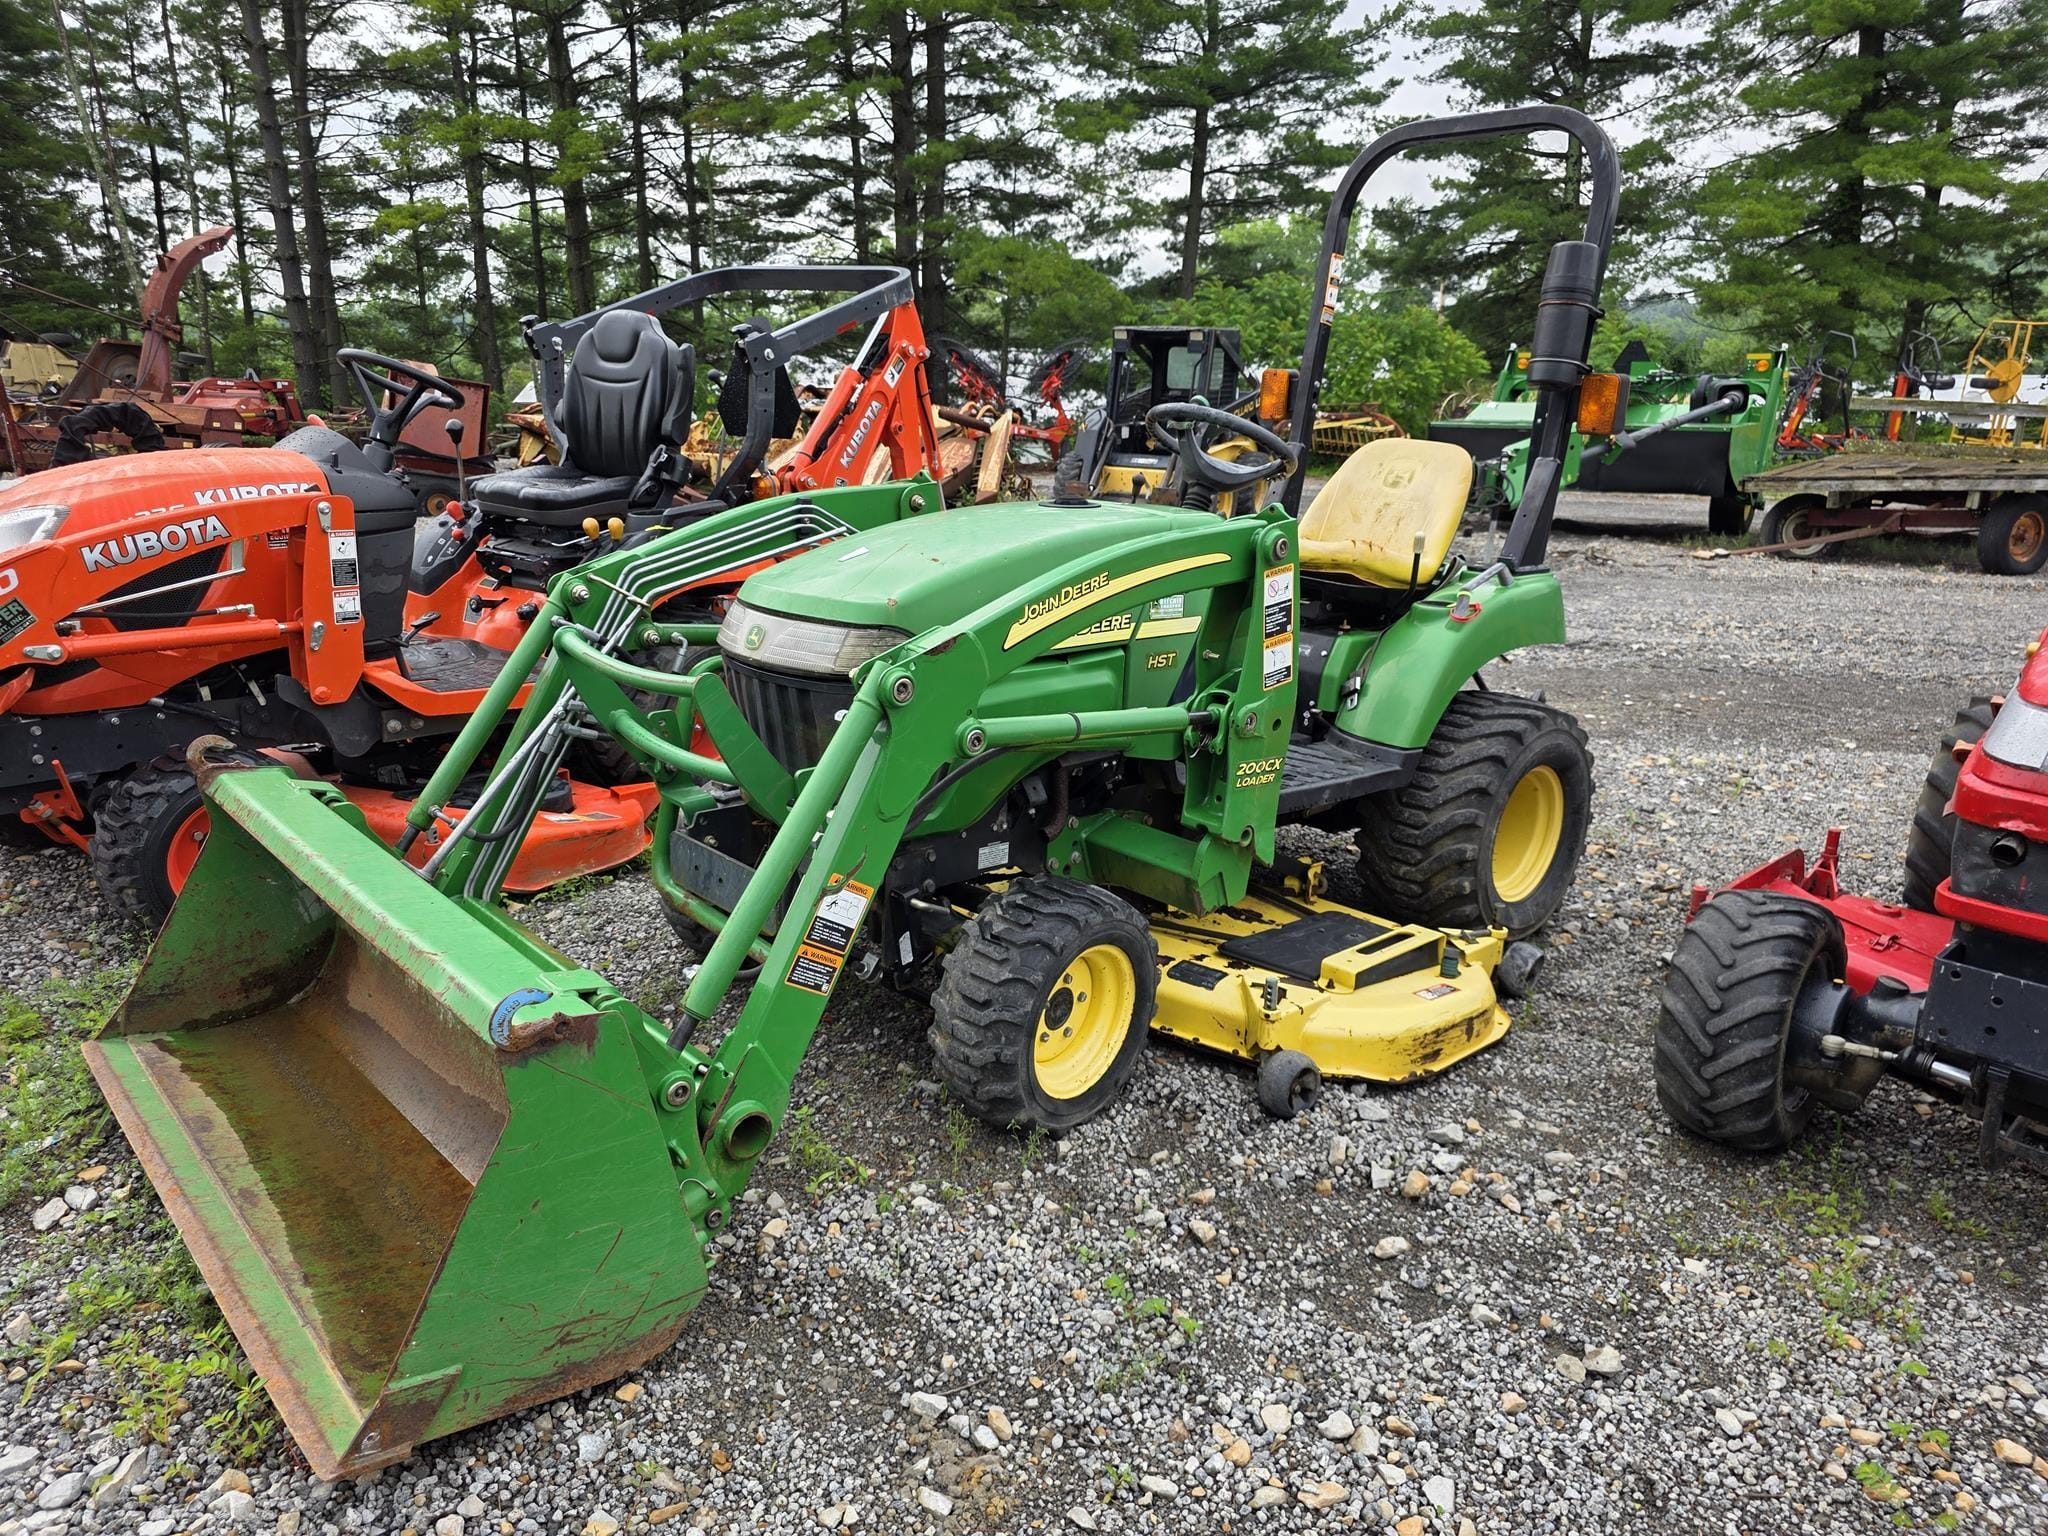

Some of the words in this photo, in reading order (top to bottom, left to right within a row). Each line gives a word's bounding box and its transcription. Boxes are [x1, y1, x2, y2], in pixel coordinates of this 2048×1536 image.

[840, 400, 881, 468] KUBOTA
[80, 514, 231, 573] KUBOTA
[1269, 565, 1292, 577] WARNING
[1019, 598, 1060, 625] JOHN
[1060, 571, 1109, 606] DEERE
[1269, 635, 1291, 648] WARNING
[1147, 652, 1177, 670] HST
[1236, 757, 1284, 776] 200CX
[1236, 773, 1276, 788] LOADER
[846, 881, 868, 895] ARNING
[810, 951, 837, 965] WARNING
